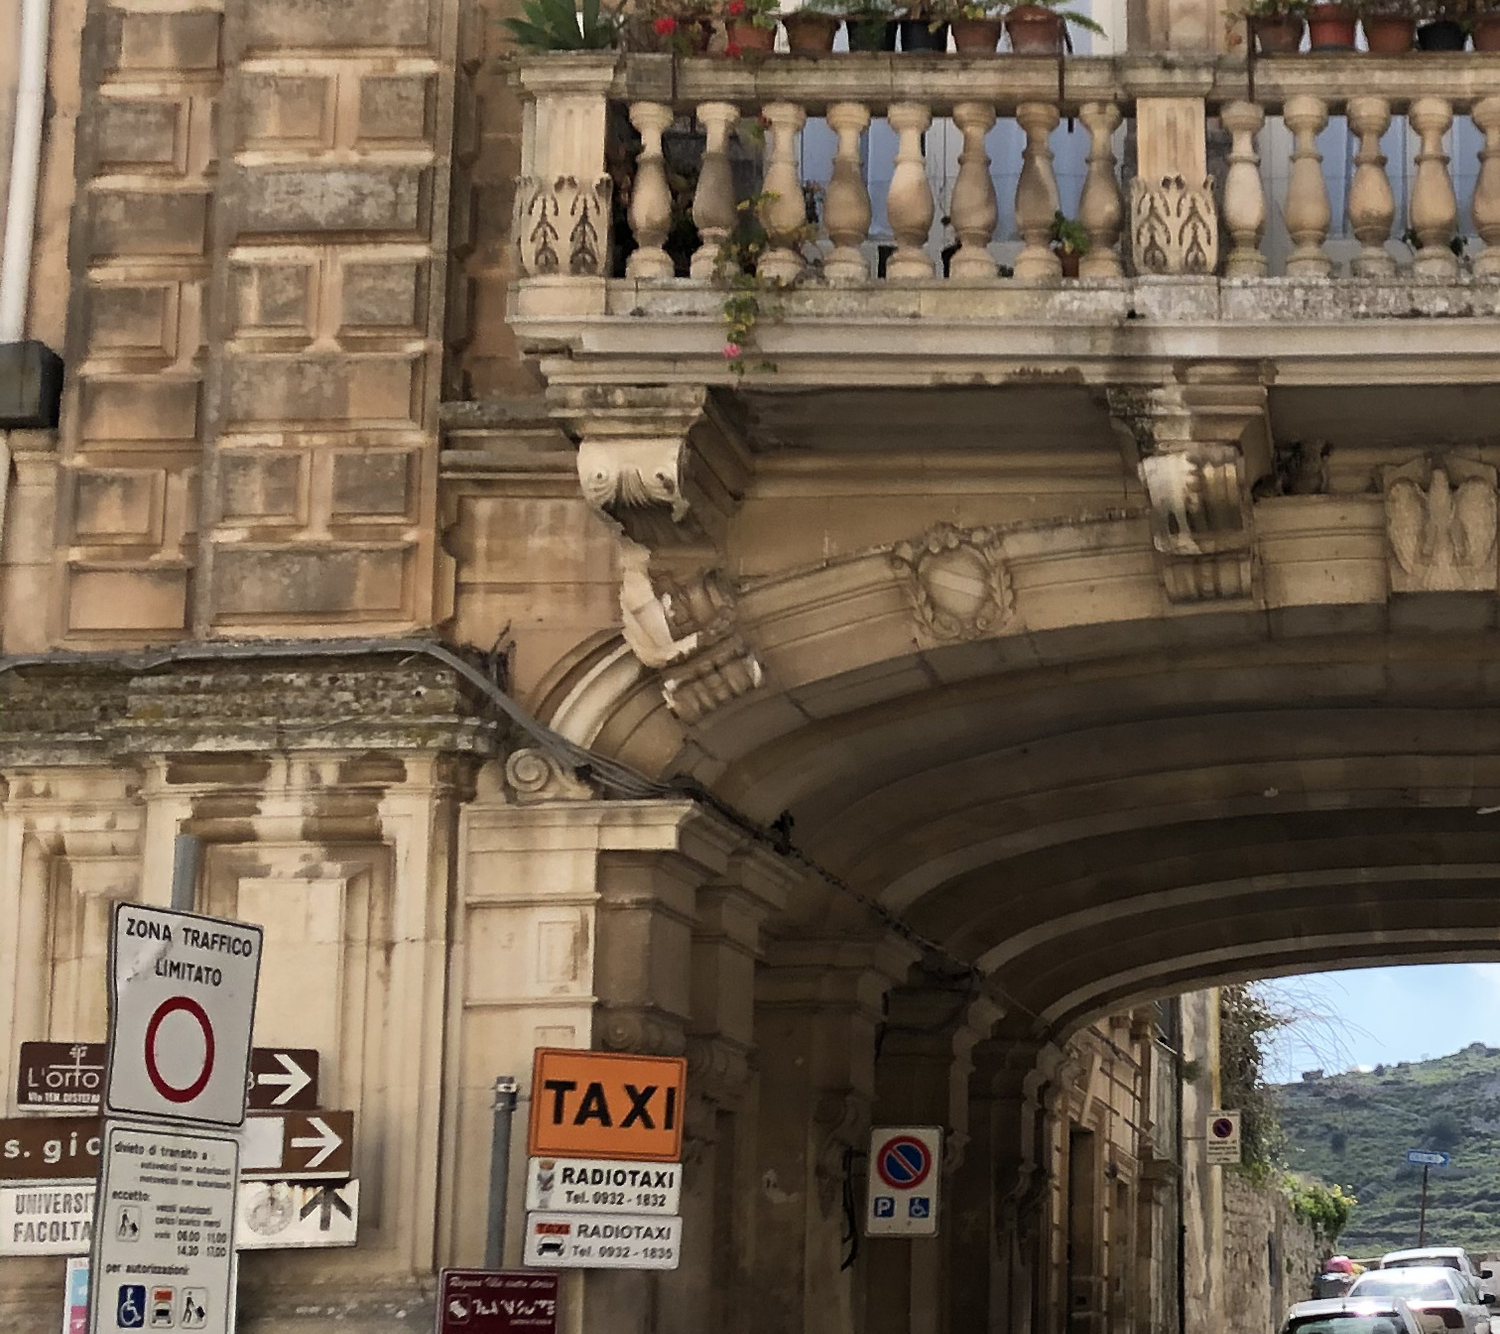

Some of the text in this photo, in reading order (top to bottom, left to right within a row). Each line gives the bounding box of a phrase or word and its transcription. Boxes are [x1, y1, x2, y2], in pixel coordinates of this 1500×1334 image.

[126, 918, 253, 958] ZONA TRAFFICO
[155, 959, 222, 987] LIMITATO
[544, 1080, 677, 1131] TAXI
[4, 1139, 31, 1158] s.
[160, 1147, 198, 1159] transito
[561, 1167, 674, 1188] RADIOTAXI
[566, 1190, 589, 1204] Tel.
[592, 1191, 625, 1205] 0932
[635, 1193, 667, 1207] 1832
[877, 1199, 891, 1216] P
[577, 1224, 671, 1240] RADIOTAXI
[600, 1246, 631, 1259] 0932
[106, 1264, 121, 1274] per
